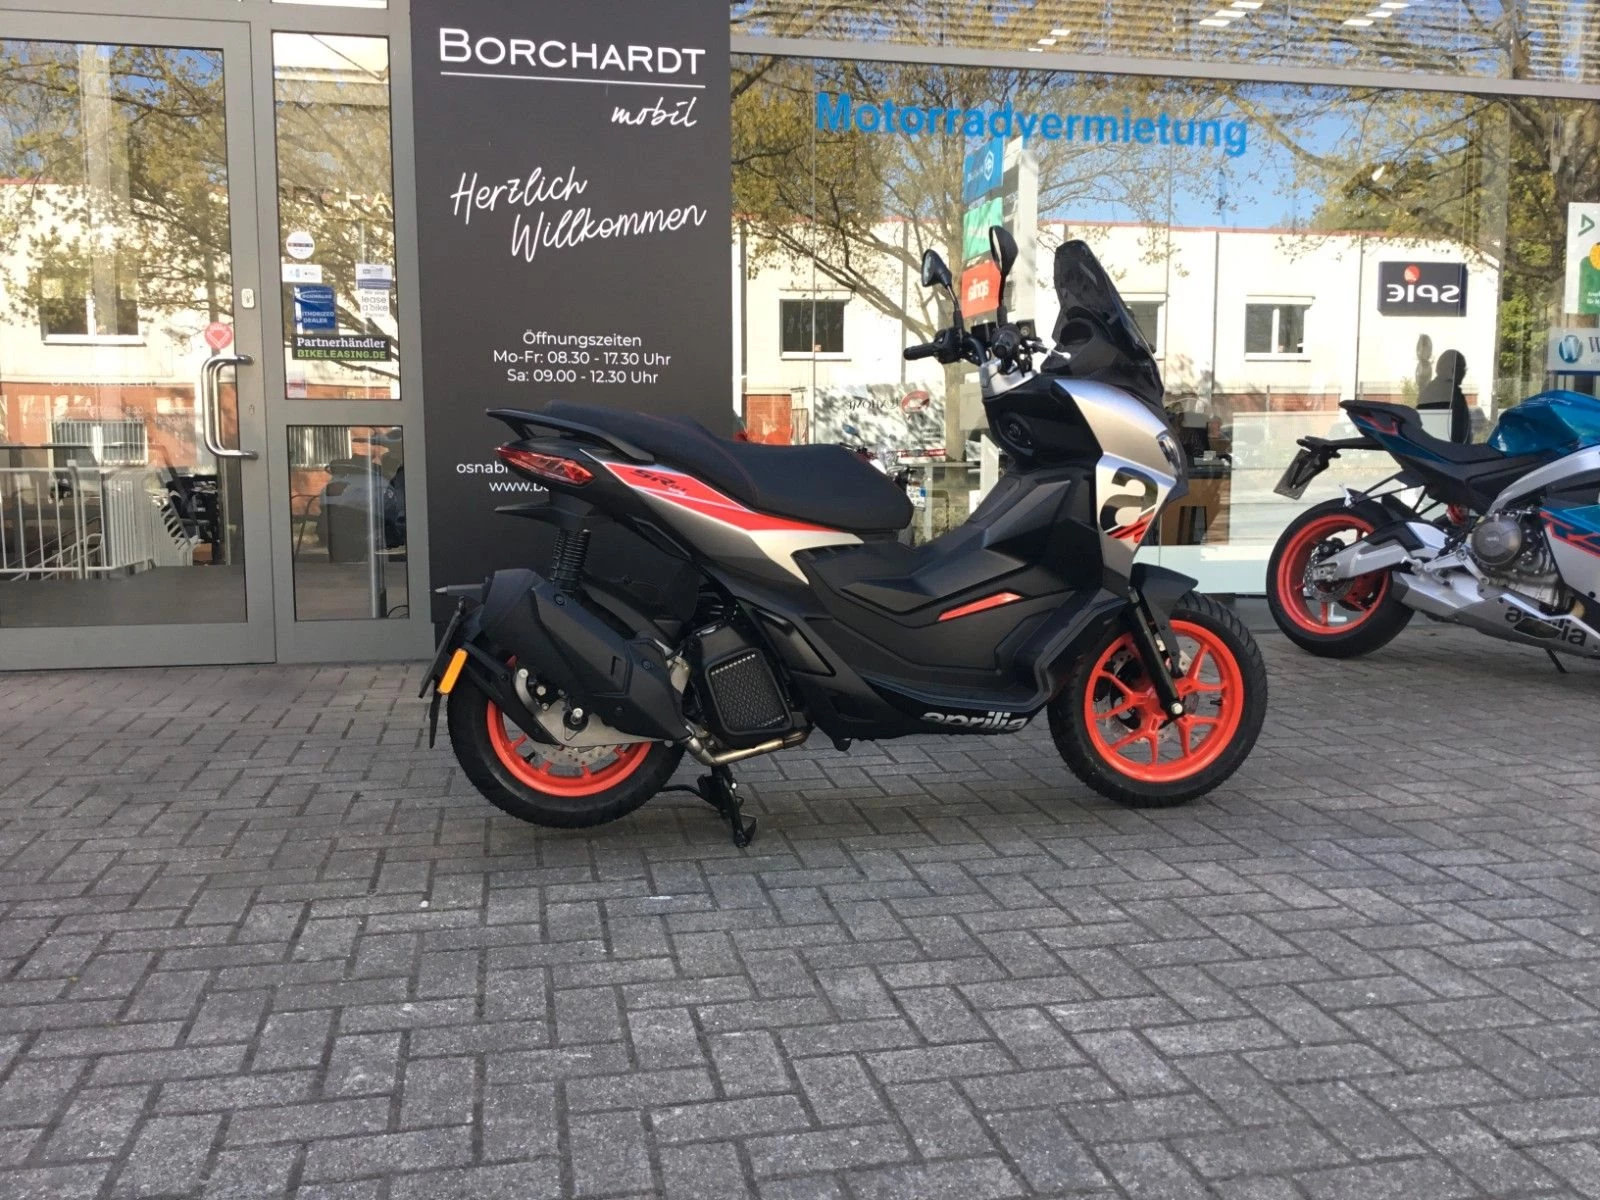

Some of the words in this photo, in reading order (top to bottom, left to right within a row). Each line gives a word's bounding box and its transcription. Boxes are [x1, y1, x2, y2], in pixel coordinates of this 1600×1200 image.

[439, 27, 706, 75] BORCHARDT
[611, 96, 697, 128] mobil
[815, 92, 1248, 157] Motorradvermietung
[450, 166, 588, 225] Herzlich
[510, 204, 707, 263] Willkommen
[297, 337, 386, 349] Partnerhändler
[522, 329, 642, 347] Öffnungszeiten
[297, 349, 386, 359] BIKELEASING.DE
[494, 350, 544, 363] Mo-Fr:
[547, 351, 590, 365] 08.30
[603, 352, 640, 366] 17.30
[644, 353, 671, 366] Uhr
[507, 369, 529, 382] Sa:
[533, 370, 576, 383] 09.00
[590, 371, 626, 384] 12.30
[631, 371, 658, 384] Uhr
[921, 711, 1029, 730] aprilia
